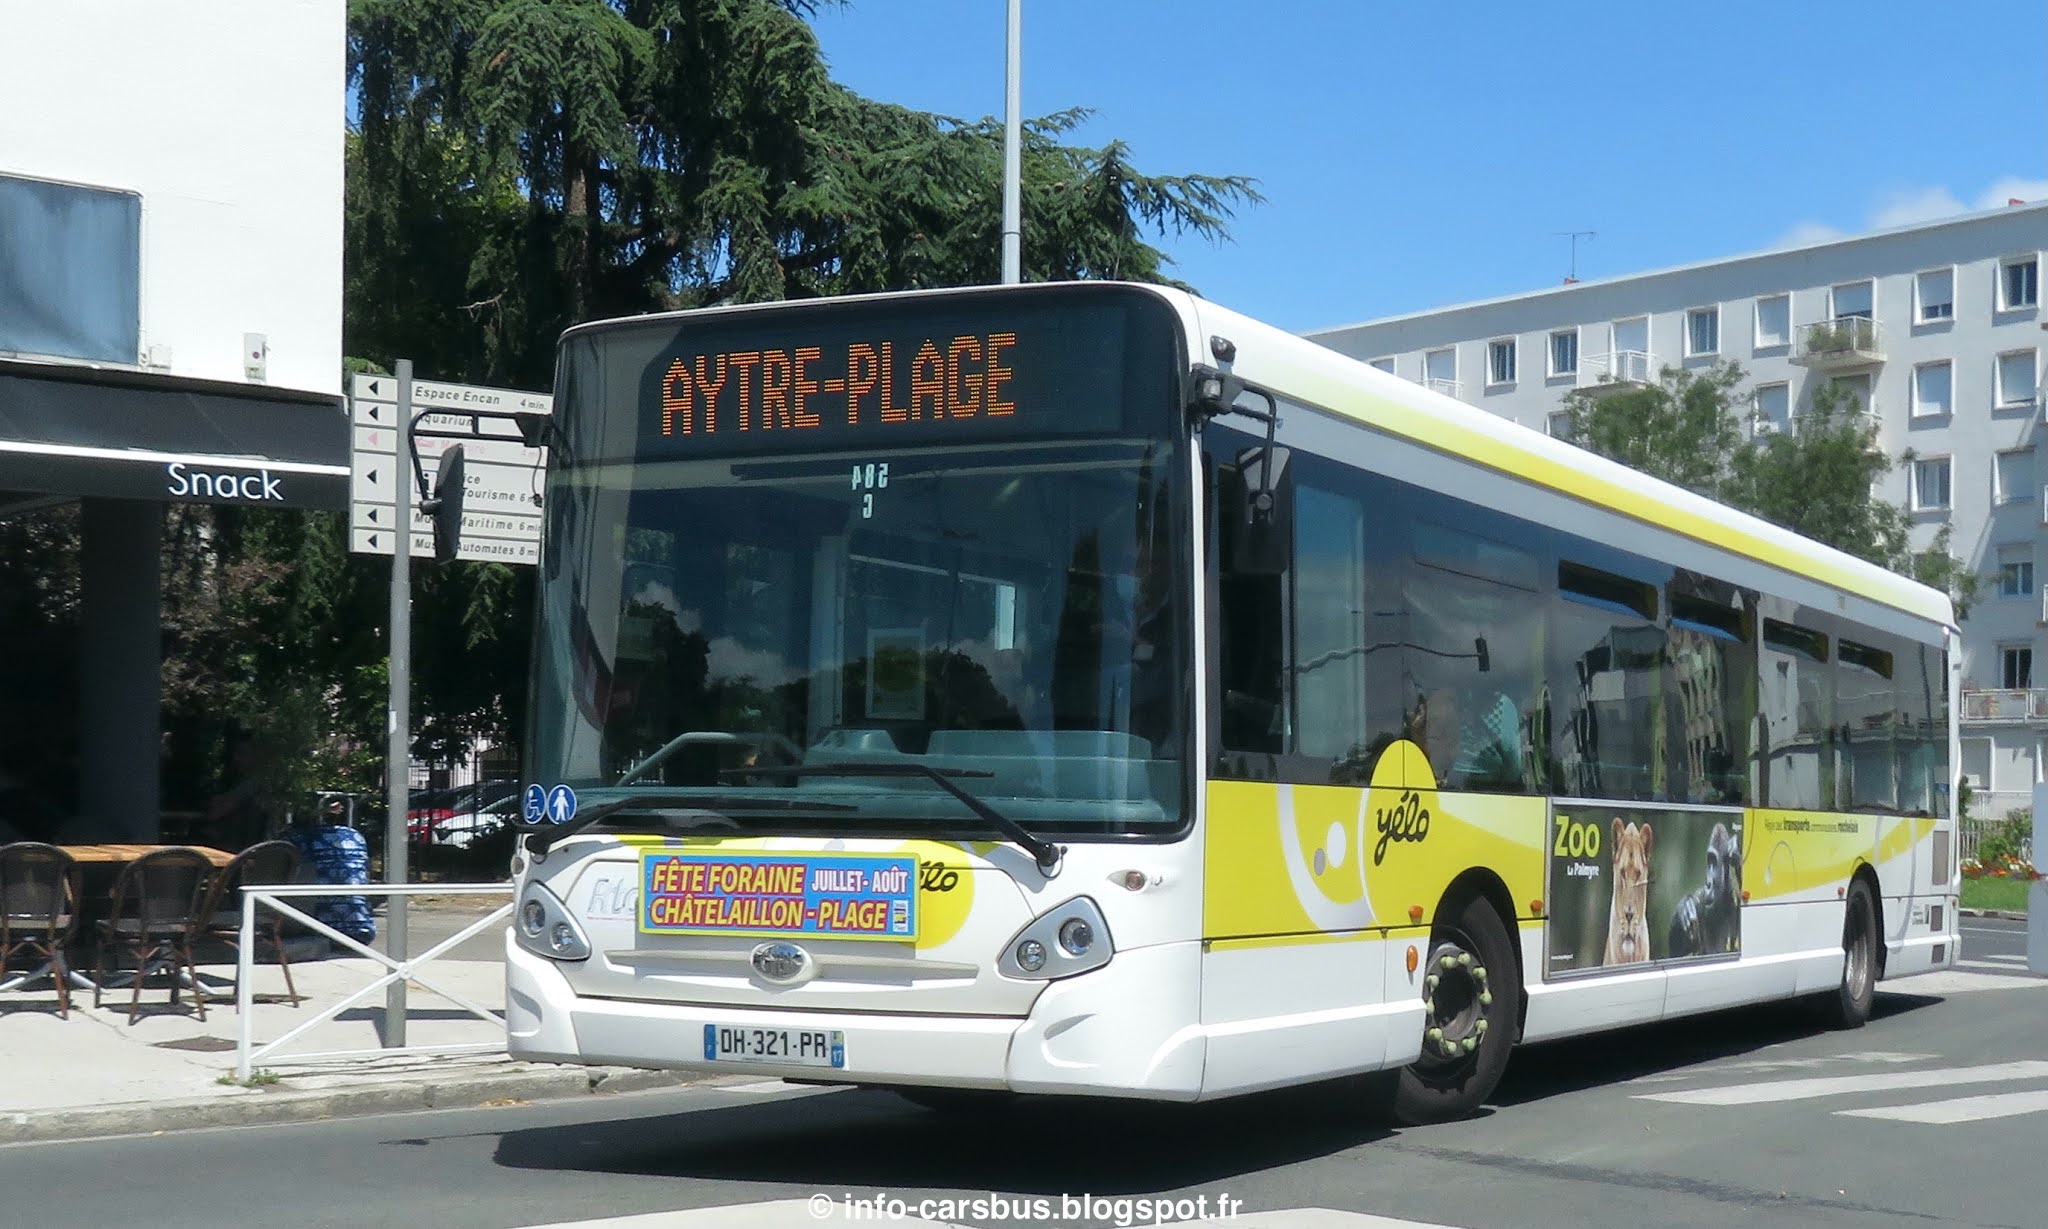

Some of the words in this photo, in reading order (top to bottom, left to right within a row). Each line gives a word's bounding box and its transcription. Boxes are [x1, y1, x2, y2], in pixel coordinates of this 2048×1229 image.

[415, 386, 460, 400] Espace
[463, 391, 500, 405] Encan
[520, 398, 526, 407] 4
[661, 331, 1016, 436] AYTRE-PLAGE
[168, 462, 284, 501] Snack
[520, 493, 526, 502] 6
[519, 521, 526, 531] 6
[519, 546, 526, 556] 8
[1373, 789, 1430, 867] yélo
[652, 858, 706, 892] FÊTE
[707, 864, 805, 894] FORAINE
[871, 865, 909, 894] AOÛT
[650, 893, 804, 928] CHÂTELAILLON
[817, 900, 889, 930] PLAGE
[720, 1028, 828, 1058] DH-321-PR
